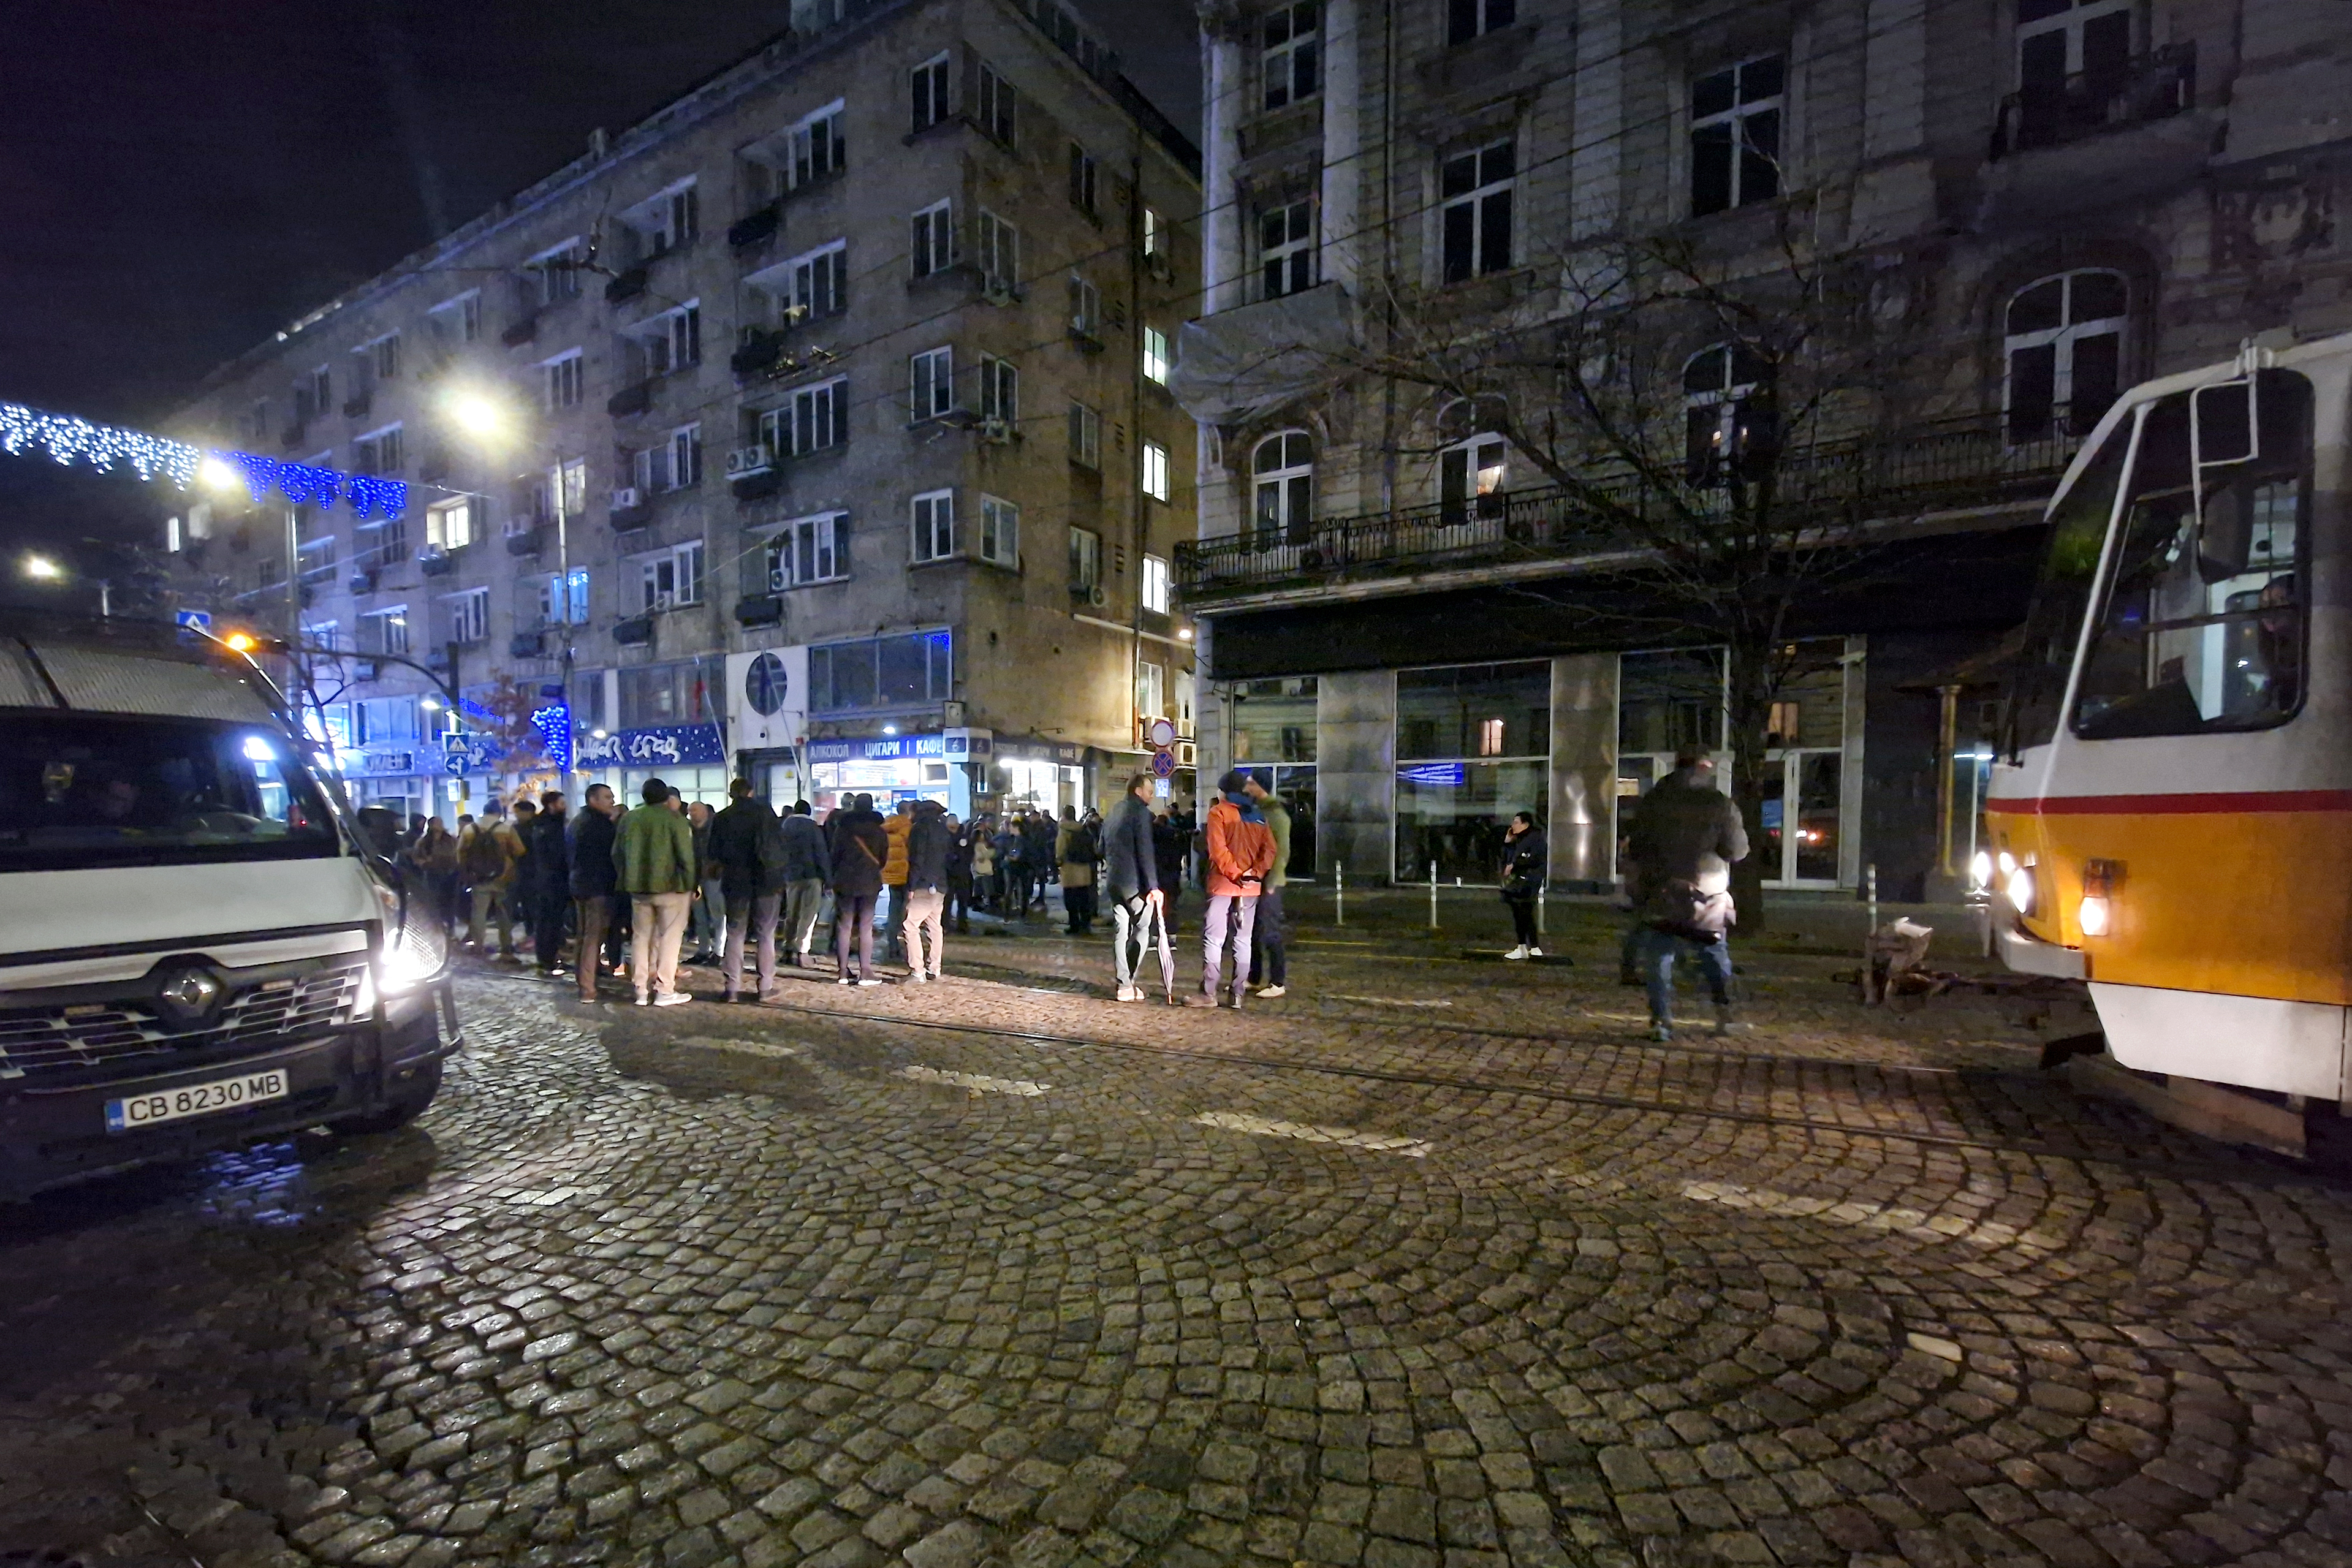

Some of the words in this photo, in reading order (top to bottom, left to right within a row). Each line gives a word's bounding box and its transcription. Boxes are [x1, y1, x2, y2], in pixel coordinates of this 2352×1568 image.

[810, 743, 849, 759] АЛКОХОЛ
[865, 740, 900, 759] ЦИГАРИ
[916, 738, 942, 755] КАФЕ
[129, 1096, 168, 1121] CB
[176, 1082, 243, 1113] 8230
[248, 1075, 281, 1099] MB
